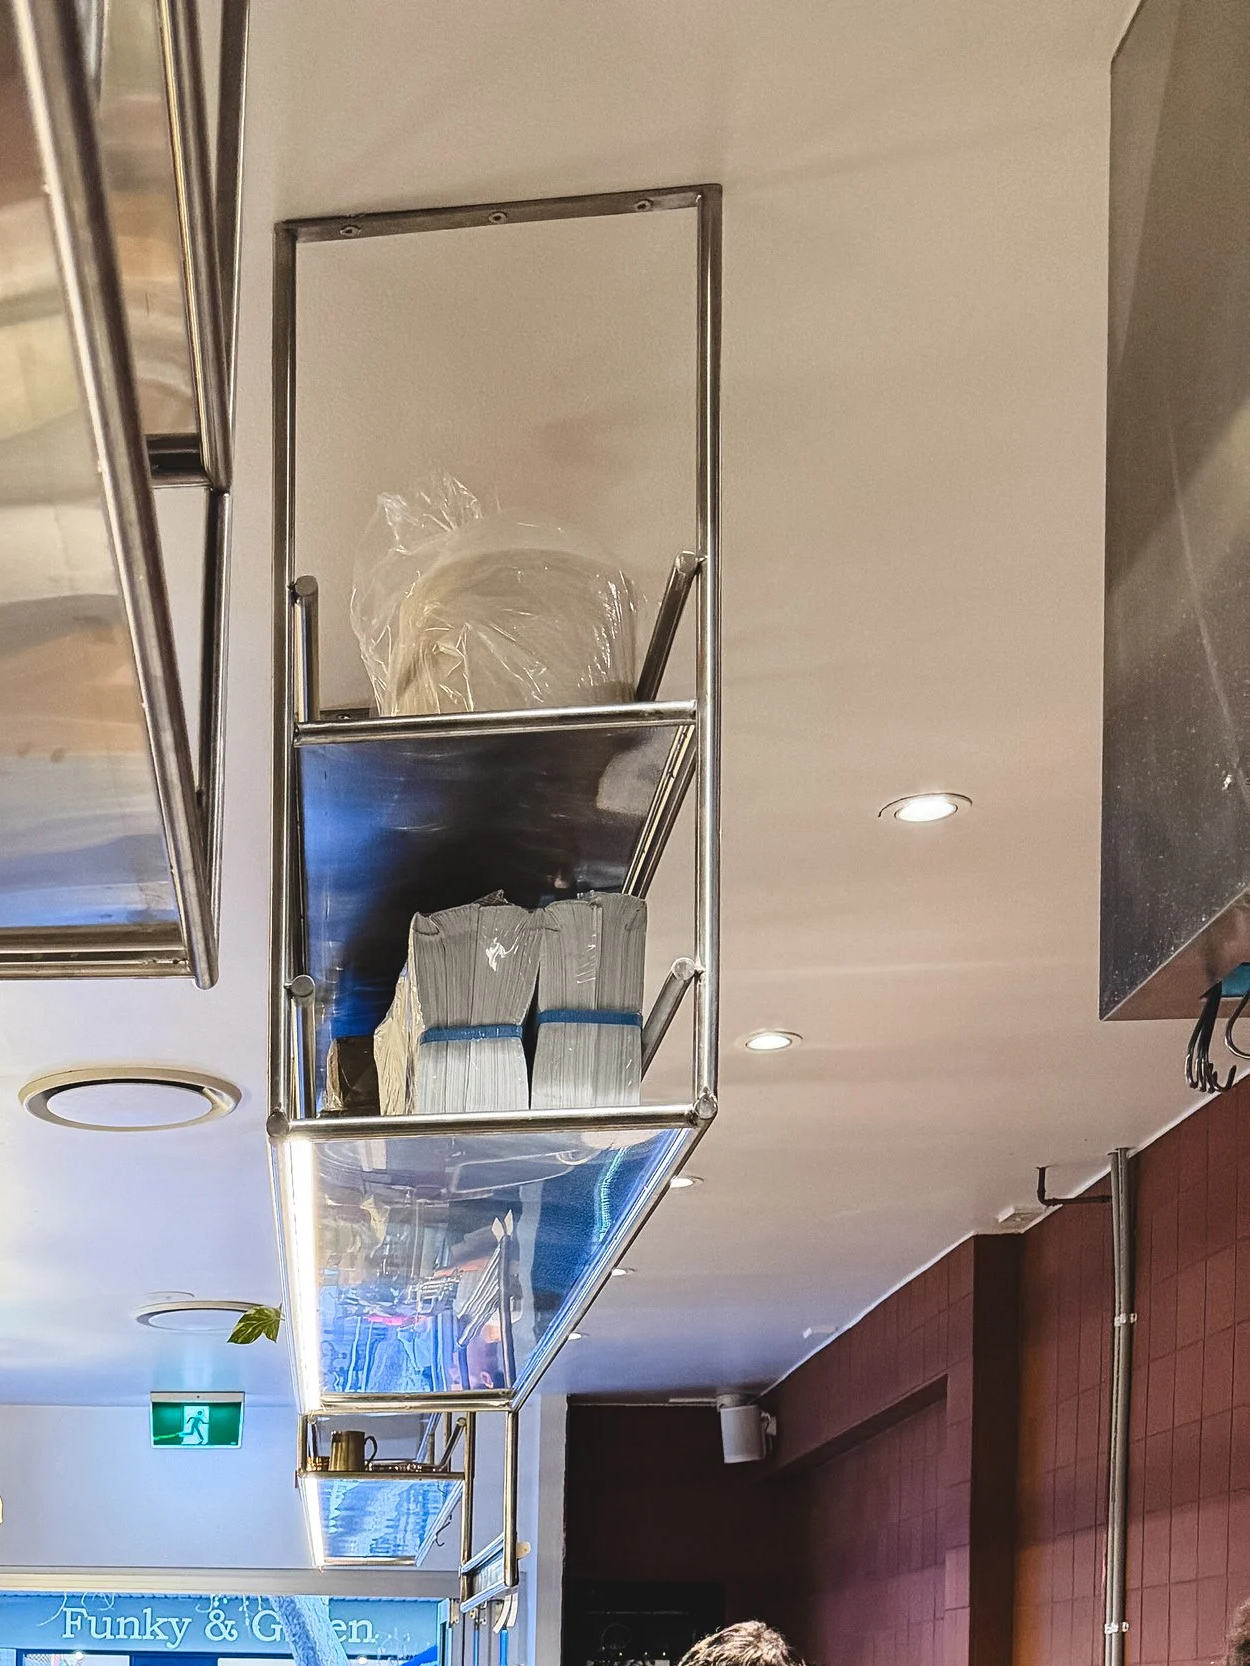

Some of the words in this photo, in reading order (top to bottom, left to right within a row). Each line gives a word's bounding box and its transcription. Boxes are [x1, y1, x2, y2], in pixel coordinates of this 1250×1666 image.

[61, 1607, 192, 1648] Funky
[204, 1609, 239, 1642] &
[251, 1609, 376, 1643] Gen
